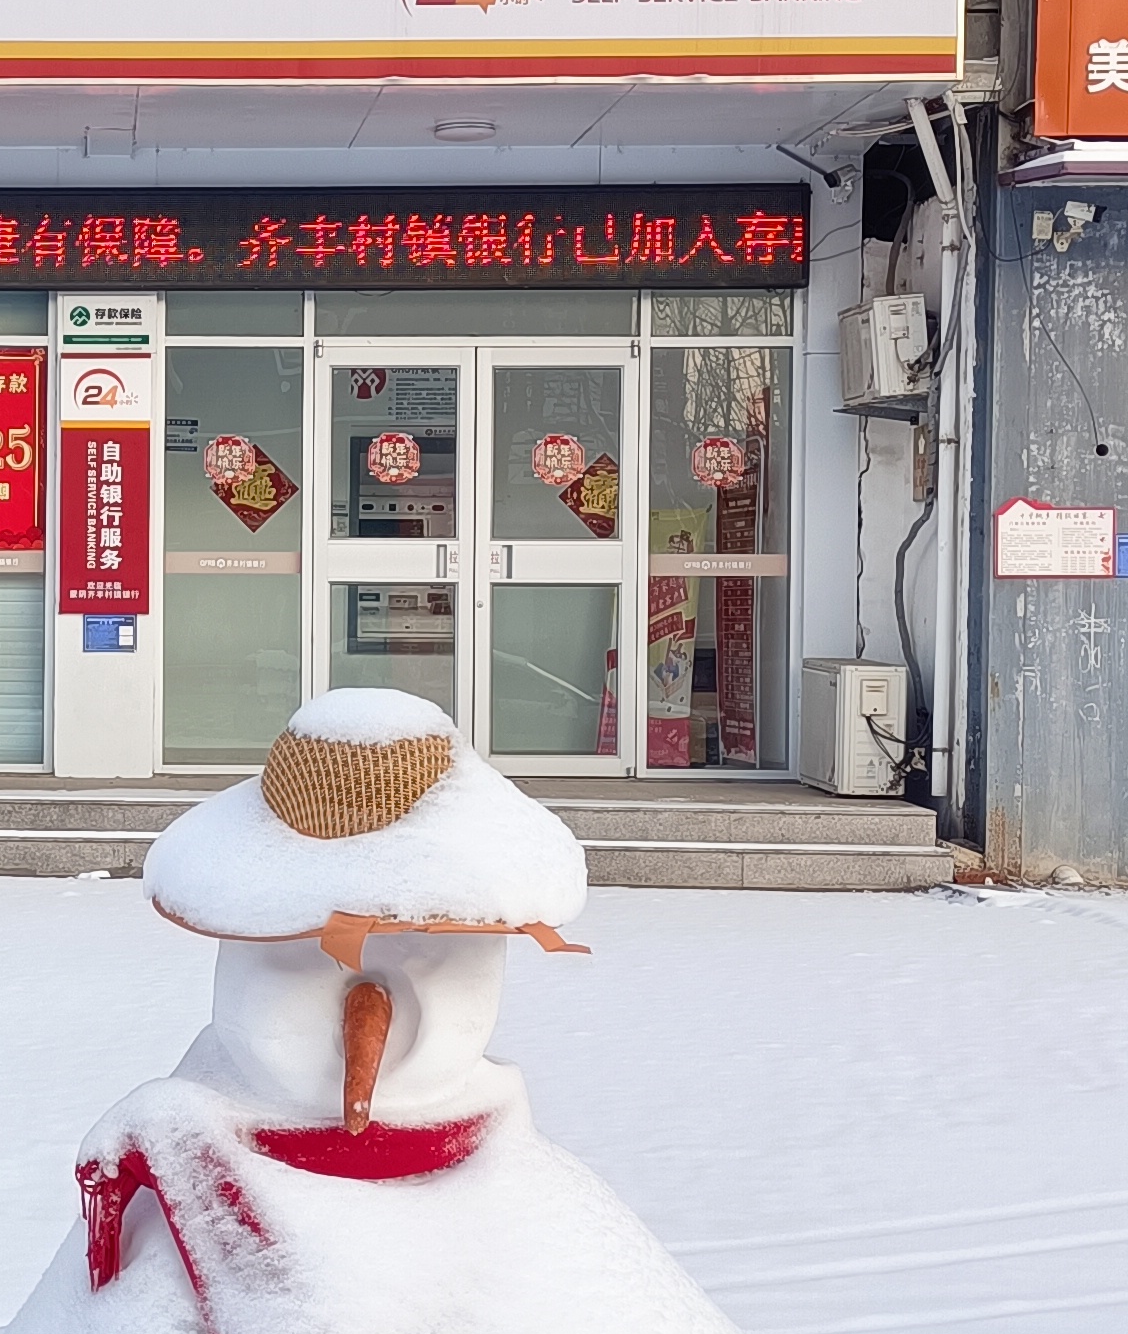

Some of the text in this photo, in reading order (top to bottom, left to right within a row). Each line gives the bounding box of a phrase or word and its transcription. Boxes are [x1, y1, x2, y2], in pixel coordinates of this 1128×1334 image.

[94, 307, 143, 320] 存款保险
[81, 385, 119, 409] 24
[87, 441, 97, 569] SELF SERVICE BANKING
[99, 440, 123, 570] 自助银行服务
